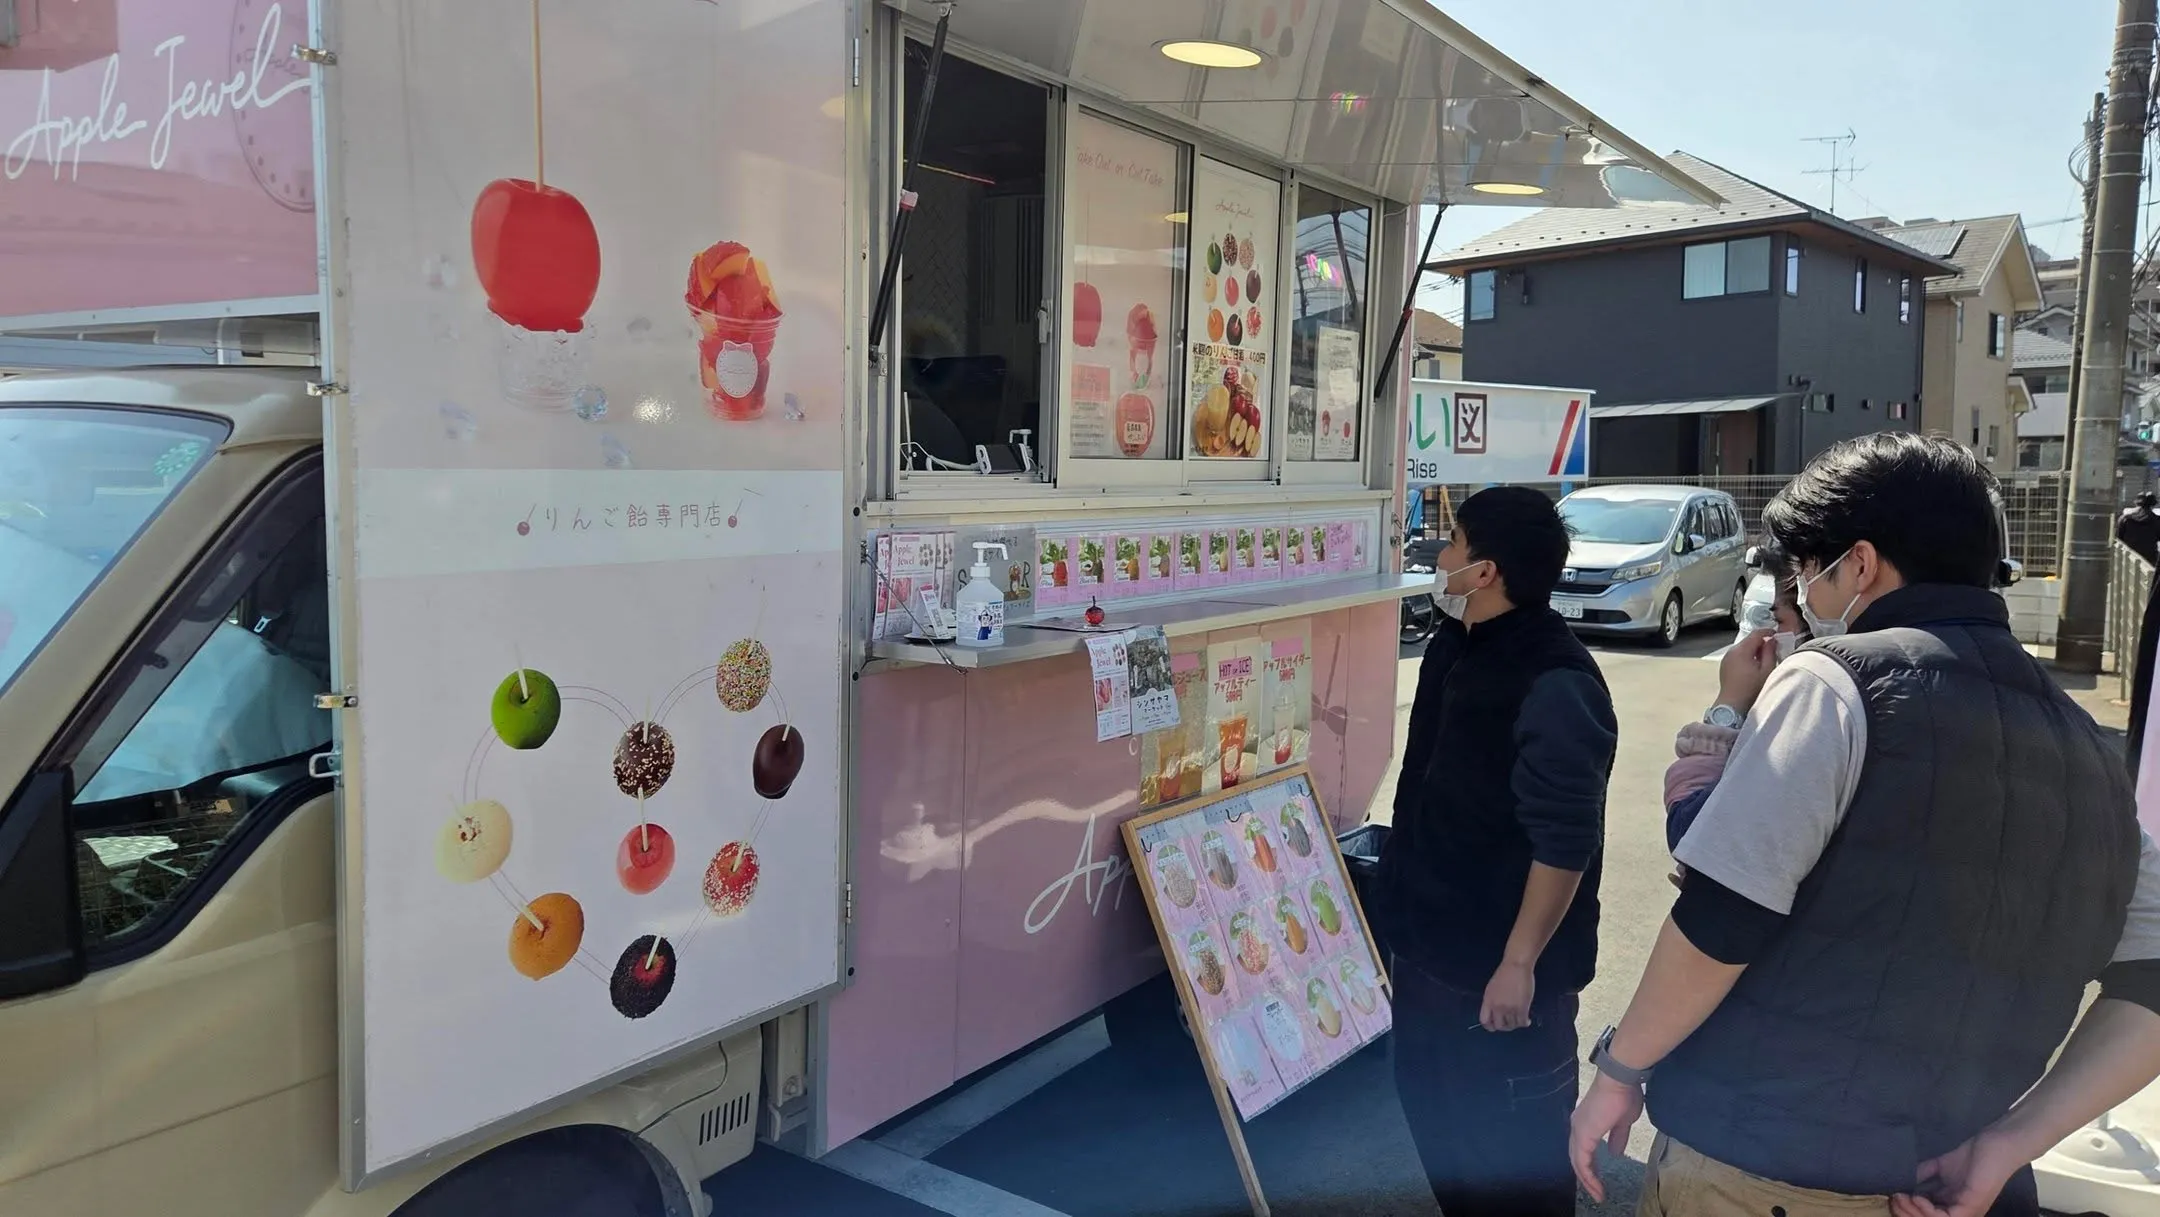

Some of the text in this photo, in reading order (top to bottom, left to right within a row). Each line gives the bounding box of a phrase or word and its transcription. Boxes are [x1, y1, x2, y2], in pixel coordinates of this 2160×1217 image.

[5, 3, 312, 181] Apple Jewel
[1407, 458, 1437, 479] Rise
[546, 502, 721, 531] りんご飴専門店
[1219, 663, 1231, 678] HOT
[1239, 658, 1250, 674] ICE
